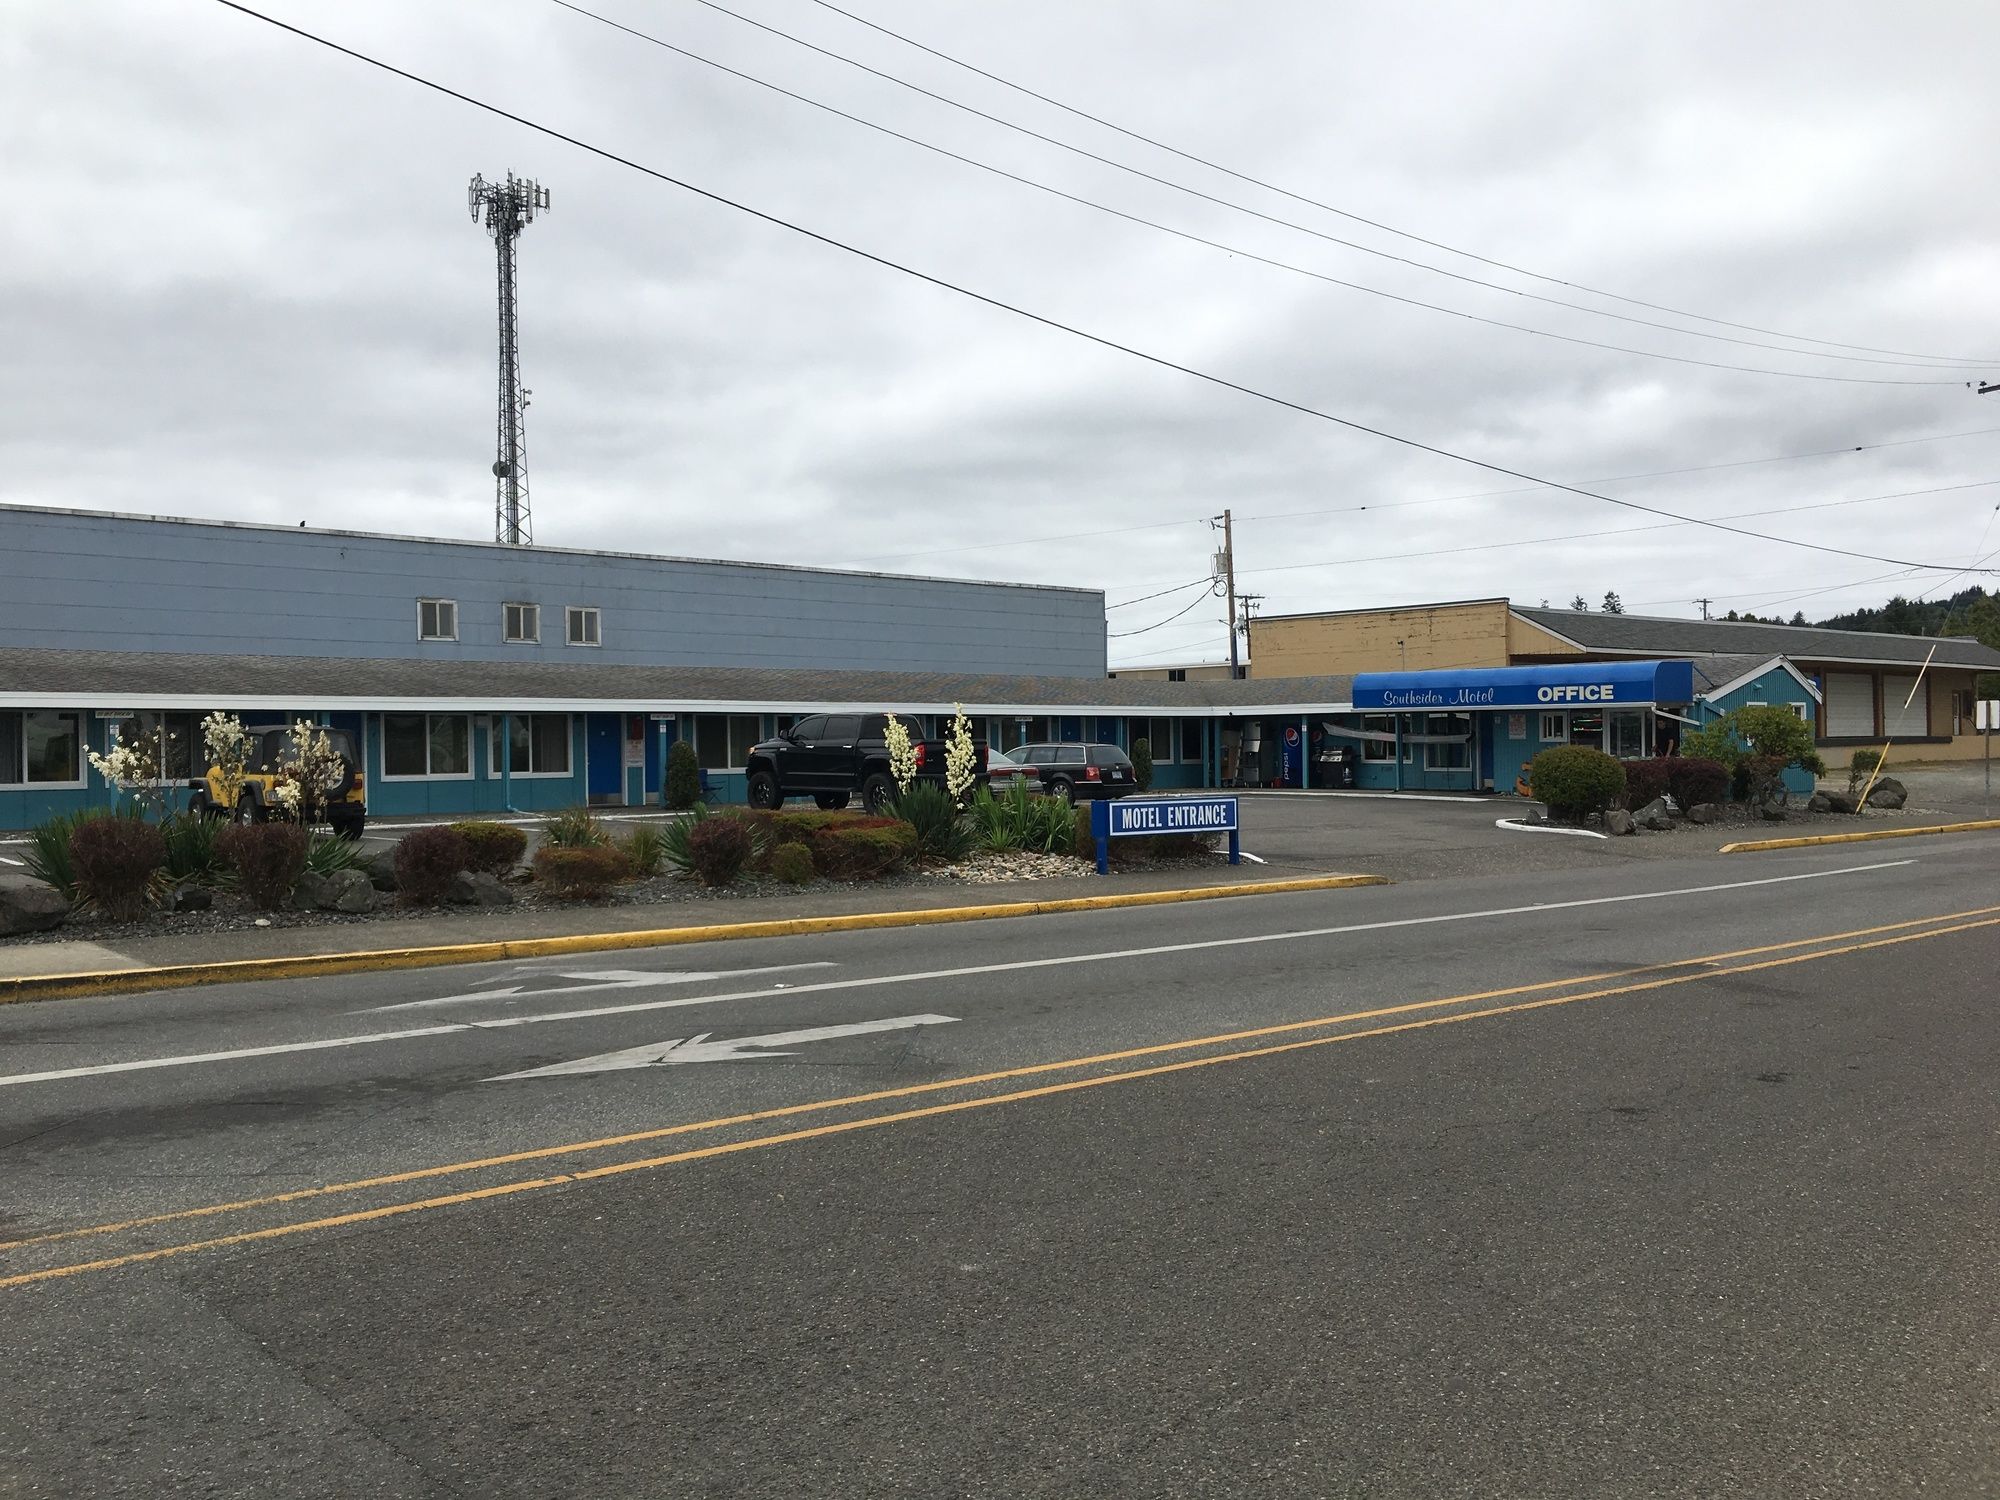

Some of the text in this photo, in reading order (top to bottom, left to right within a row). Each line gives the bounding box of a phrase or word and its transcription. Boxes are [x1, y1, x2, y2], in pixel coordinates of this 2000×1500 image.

[1383, 688, 1494, 706] Southsider Motel
[1537, 685, 1614, 702] OFFICE
[1122, 804, 1227, 829] MOTEL ENTRANCE
